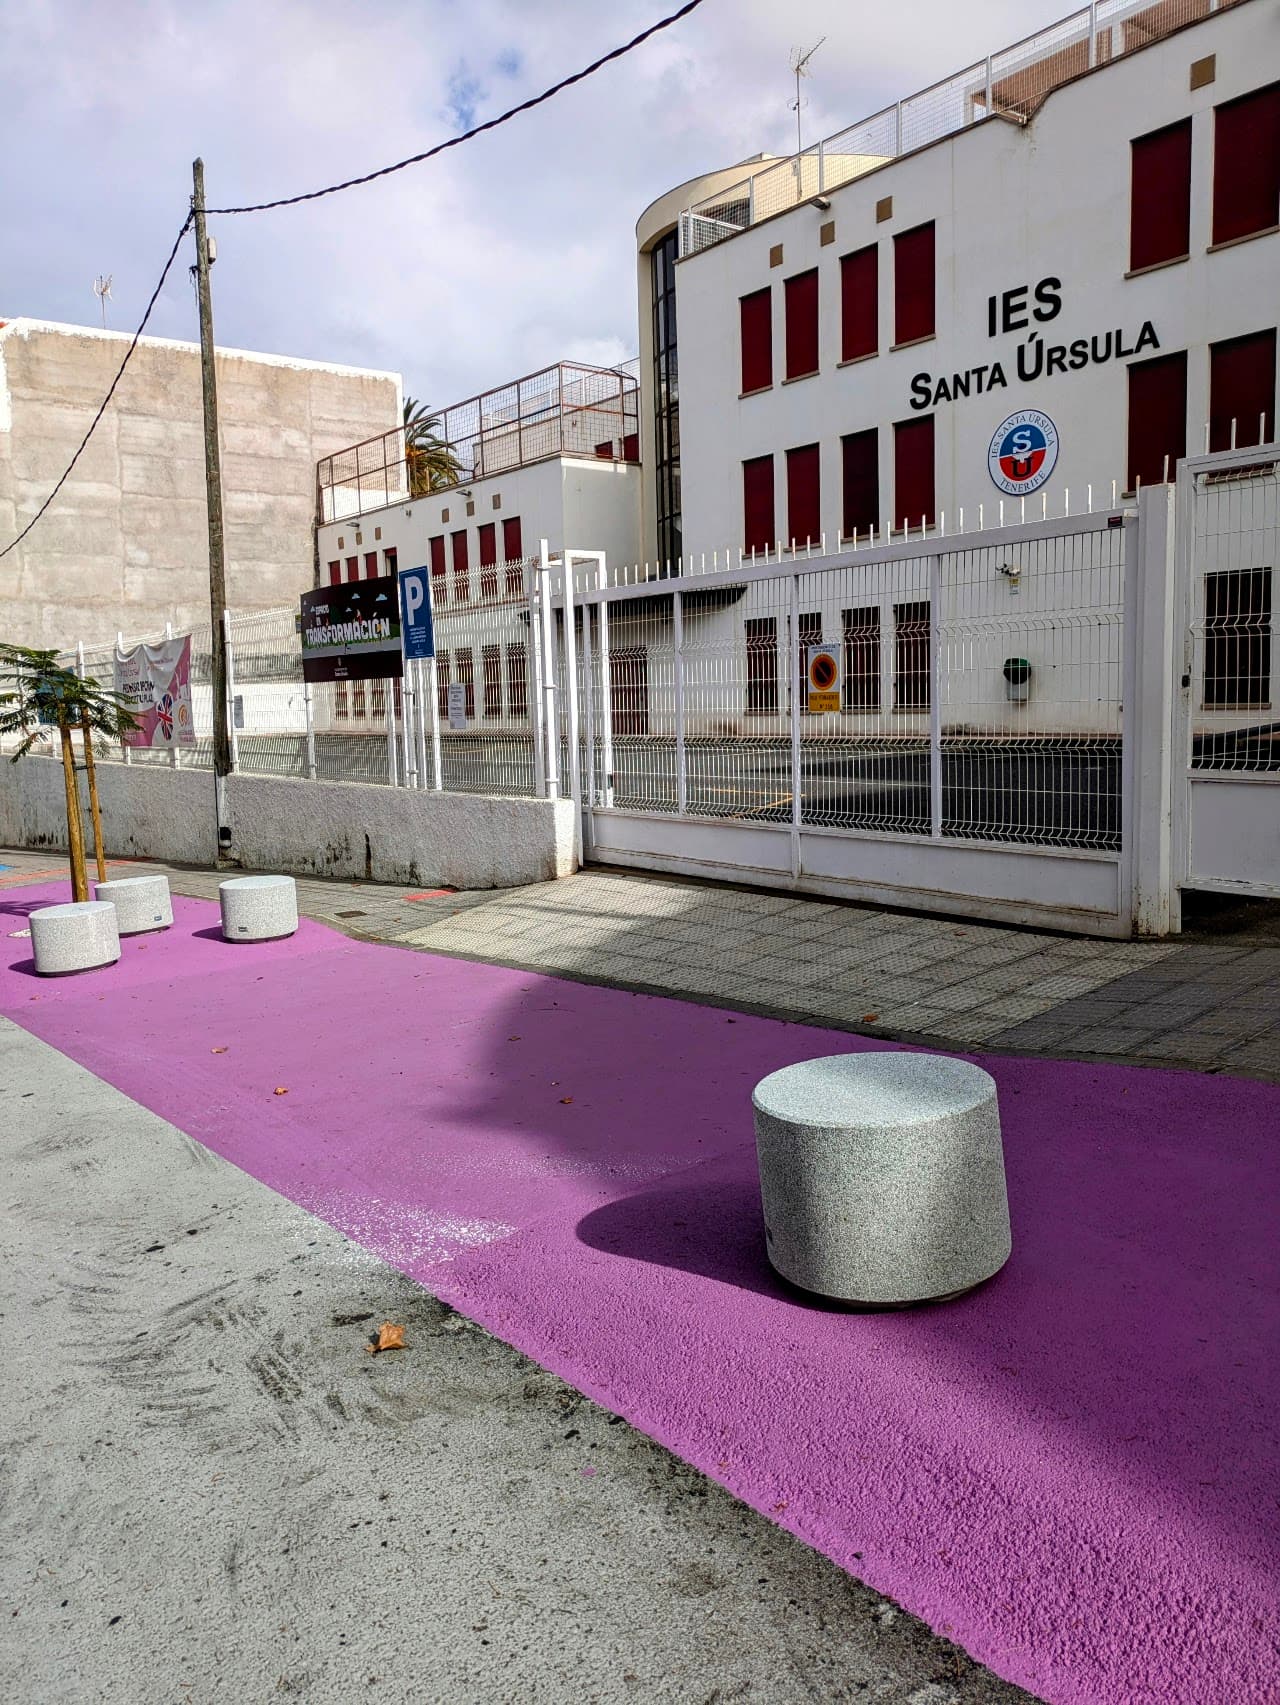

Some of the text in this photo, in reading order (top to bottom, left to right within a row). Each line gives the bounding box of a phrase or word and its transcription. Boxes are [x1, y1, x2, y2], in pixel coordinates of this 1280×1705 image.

[988, 277, 1062, 337] IES
[909, 321, 1160, 409] SANTA ÚRSULA
[991, 412, 1055, 458] IES SANTA ÚRSULA
[999, 470, 1046, 492] TENERIFE
[404, 575, 424, 625] P
[305, 611, 391, 646] TRANSFORMACIÓN
